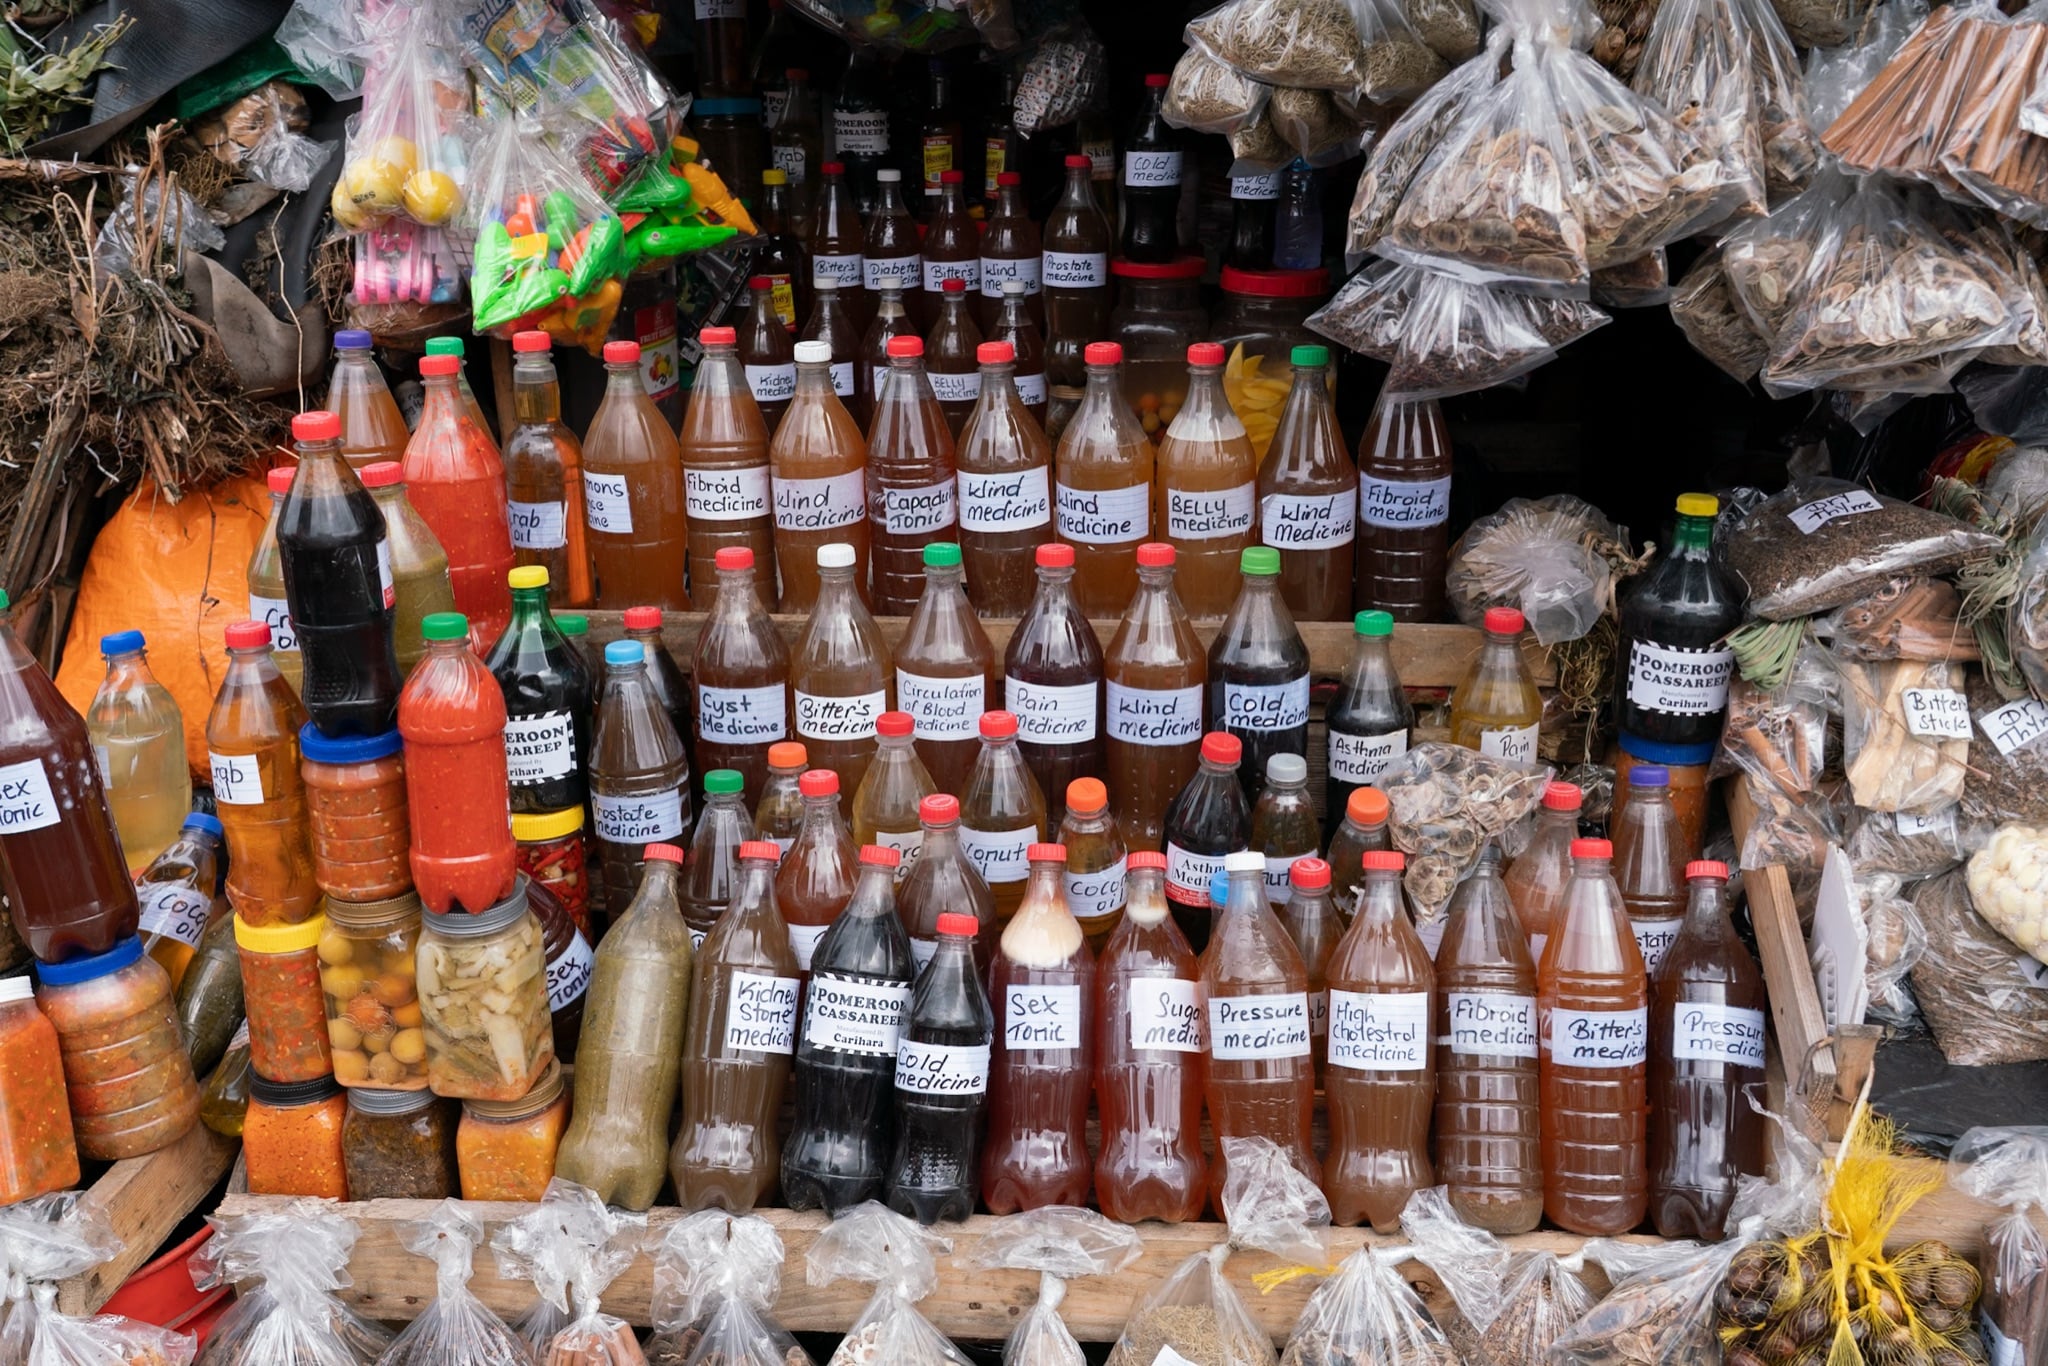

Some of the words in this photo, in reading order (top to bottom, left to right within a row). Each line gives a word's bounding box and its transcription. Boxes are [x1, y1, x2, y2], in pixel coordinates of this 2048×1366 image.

[779, 151, 804, 162] rab
[1134, 156, 1170, 170] Cold
[1045, 254, 1093, 271] Prostate
[1045, 271, 1096, 283] medicine
[934, 376, 965, 390] BELLY
[935, 387, 978, 399] medicine
[687, 496, 764, 512] medicine
[1368, 484, 1434, 507] Fibroid
[509, 505, 541, 528] rab
[777, 504, 866, 528] medicine
[967, 497, 1047, 522] medicine
[1171, 495, 1226, 519] BELLY
[1369, 503, 1446, 521] medicine
[889, 510, 943, 530] Tonic
[1171, 513, 1249, 533] medicine
[1638, 653, 1732, 676] POMEROON
[1640, 669, 1728, 689] CASSAREEP
[903, 680, 983, 700] Circulation
[1016, 687, 1059, 712] Pain
[702, 692, 752, 719] Cyst
[904, 700, 918, 711] of
[923, 701, 967, 717] Blood
[1229, 691, 1286, 713] Cold
[1658, 696, 1709, 709] Carihara
[802, 718, 875, 735] medicin
[914, 718, 971, 732] edicine
[1230, 706, 1309, 728] medicine
[505, 725, 565, 744] EROON
[1119, 718, 1201, 739] medicine
[506, 740, 563, 757] SAREEP
[1335, 737, 1392, 758] Asthma
[1499, 734, 1530, 758] Pain
[211, 759, 244, 784] rab
[509, 767, 545, 777] rihara
[1334, 759, 1389, 775] medicin
[1182, 859, 1226, 874] Asthm
[737, 980, 797, 1011] Kidney
[1011, 993, 1059, 1016] Sex
[739, 1001, 792, 1024] Stone
[1155, 991, 1201, 1028] Suga
[1220, 1003, 1303, 1024] Pressure
[1336, 1001, 1375, 1024] High
[1456, 998, 1529, 1025] Fibroid
[833, 1032, 884, 1048] Carihara
[1007, 1021, 1065, 1042] Tonic
[1224, 1028, 1307, 1049] medicine
[898, 1046, 949, 1073] Cold
[1335, 1045, 1417, 1061] medicine
[896, 1071, 981, 1091] medicine
